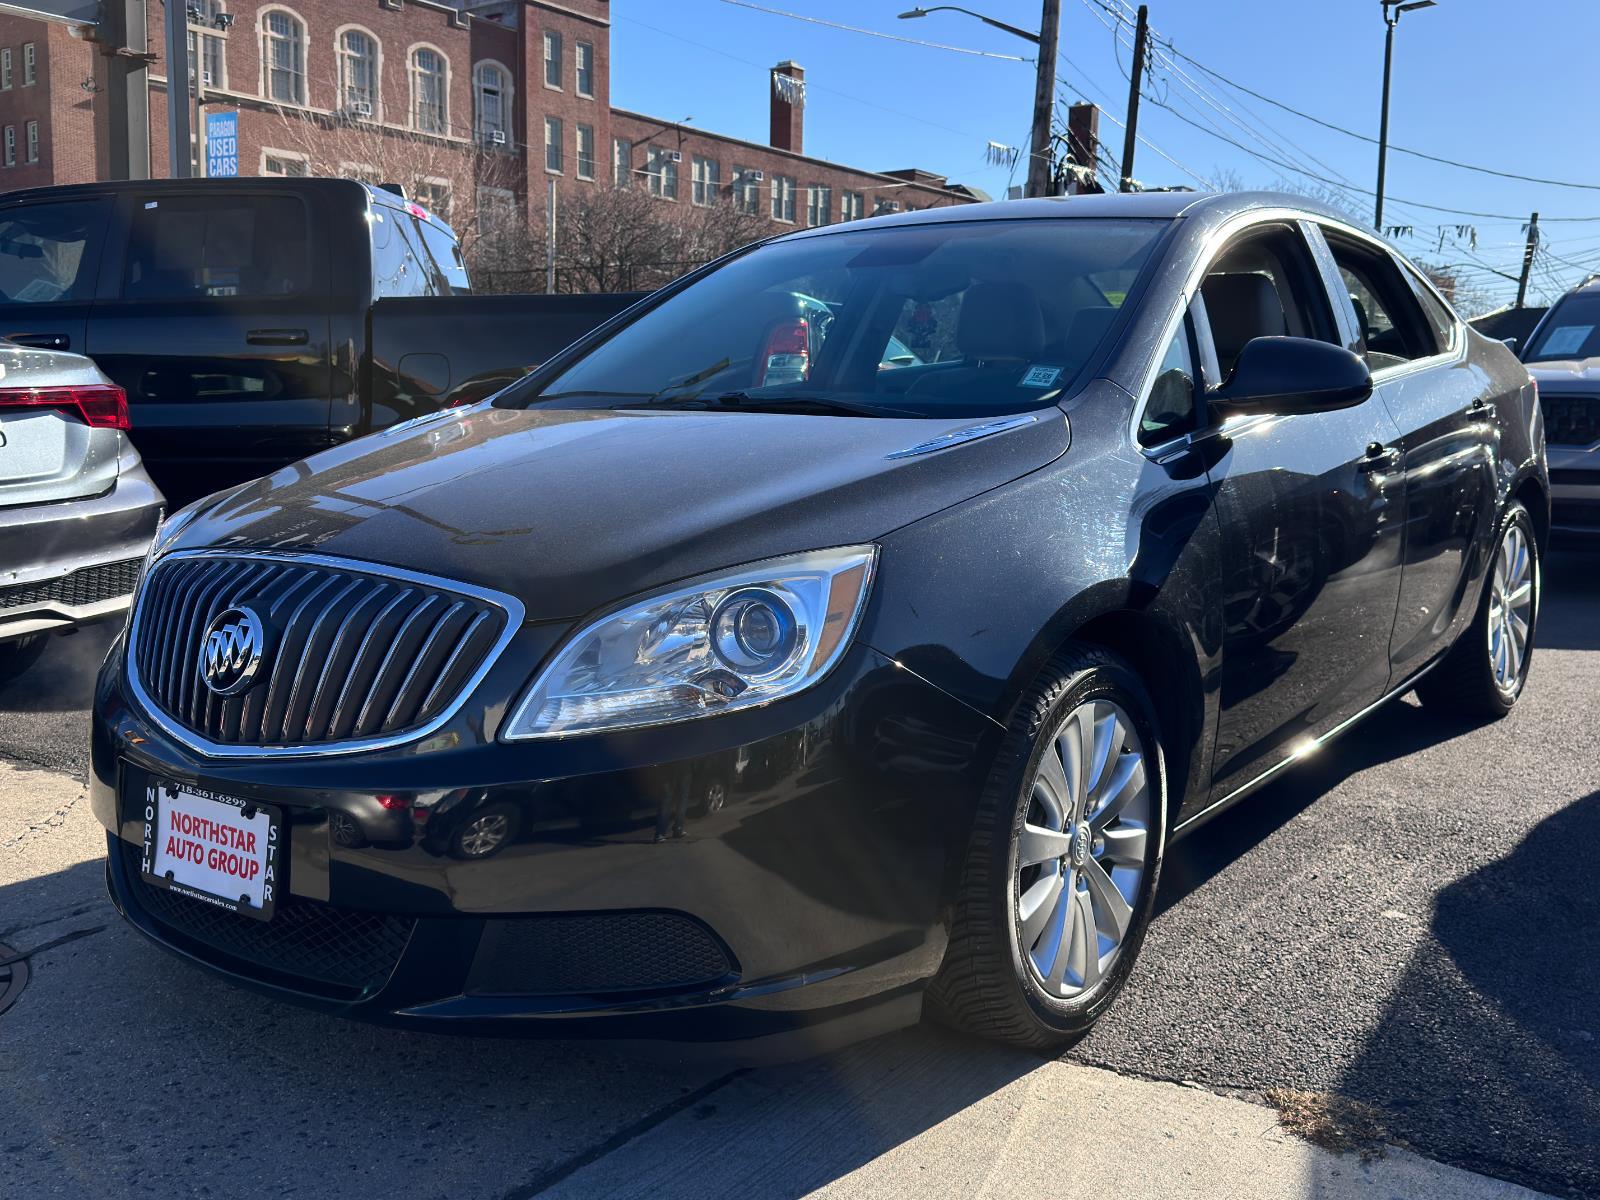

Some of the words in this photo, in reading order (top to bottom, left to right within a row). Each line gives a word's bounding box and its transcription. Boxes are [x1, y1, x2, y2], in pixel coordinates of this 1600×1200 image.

[209, 137, 236, 158] USED
[209, 156, 237, 177] CARS
[174, 782, 247, 808] 718-361-6299
[141, 786, 156, 874] NORTH
[170, 810, 257, 855] NORTHSTAR
[165, 835, 205, 865] AUTO
[207, 848, 260, 881] GROUP
[263, 825, 278, 902] STAR
